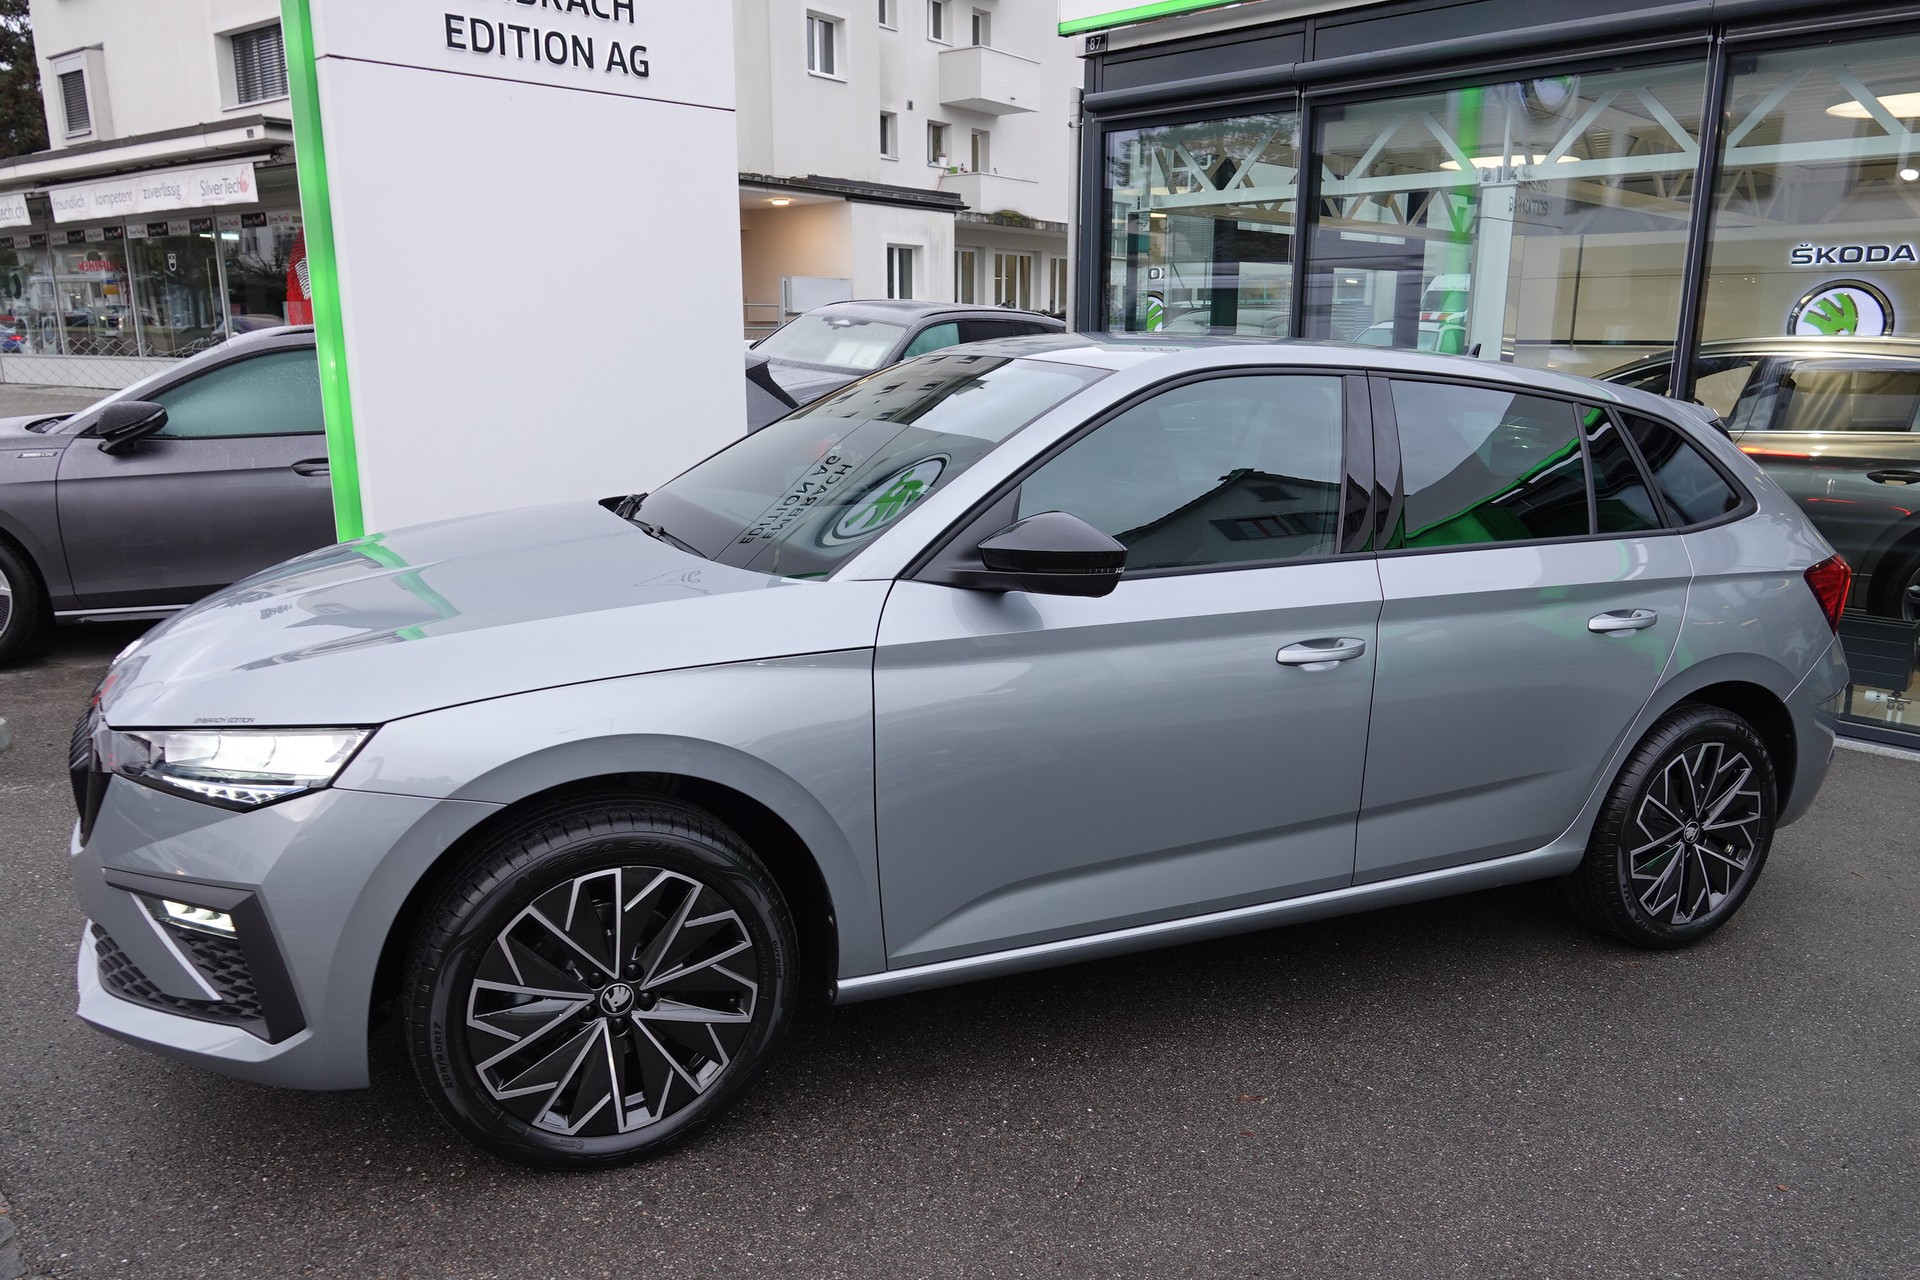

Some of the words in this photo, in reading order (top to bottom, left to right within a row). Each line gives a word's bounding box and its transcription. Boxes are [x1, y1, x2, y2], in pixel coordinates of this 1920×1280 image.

[445, 13, 594, 69] EDITION
[605, 41, 650, 78] AG
[1090, 37, 1101, 50] 87
[53, 194, 86, 211] freundlich
[95, 190, 133, 208] kompetent
[1790, 243, 1916, 265] ŠKODA
